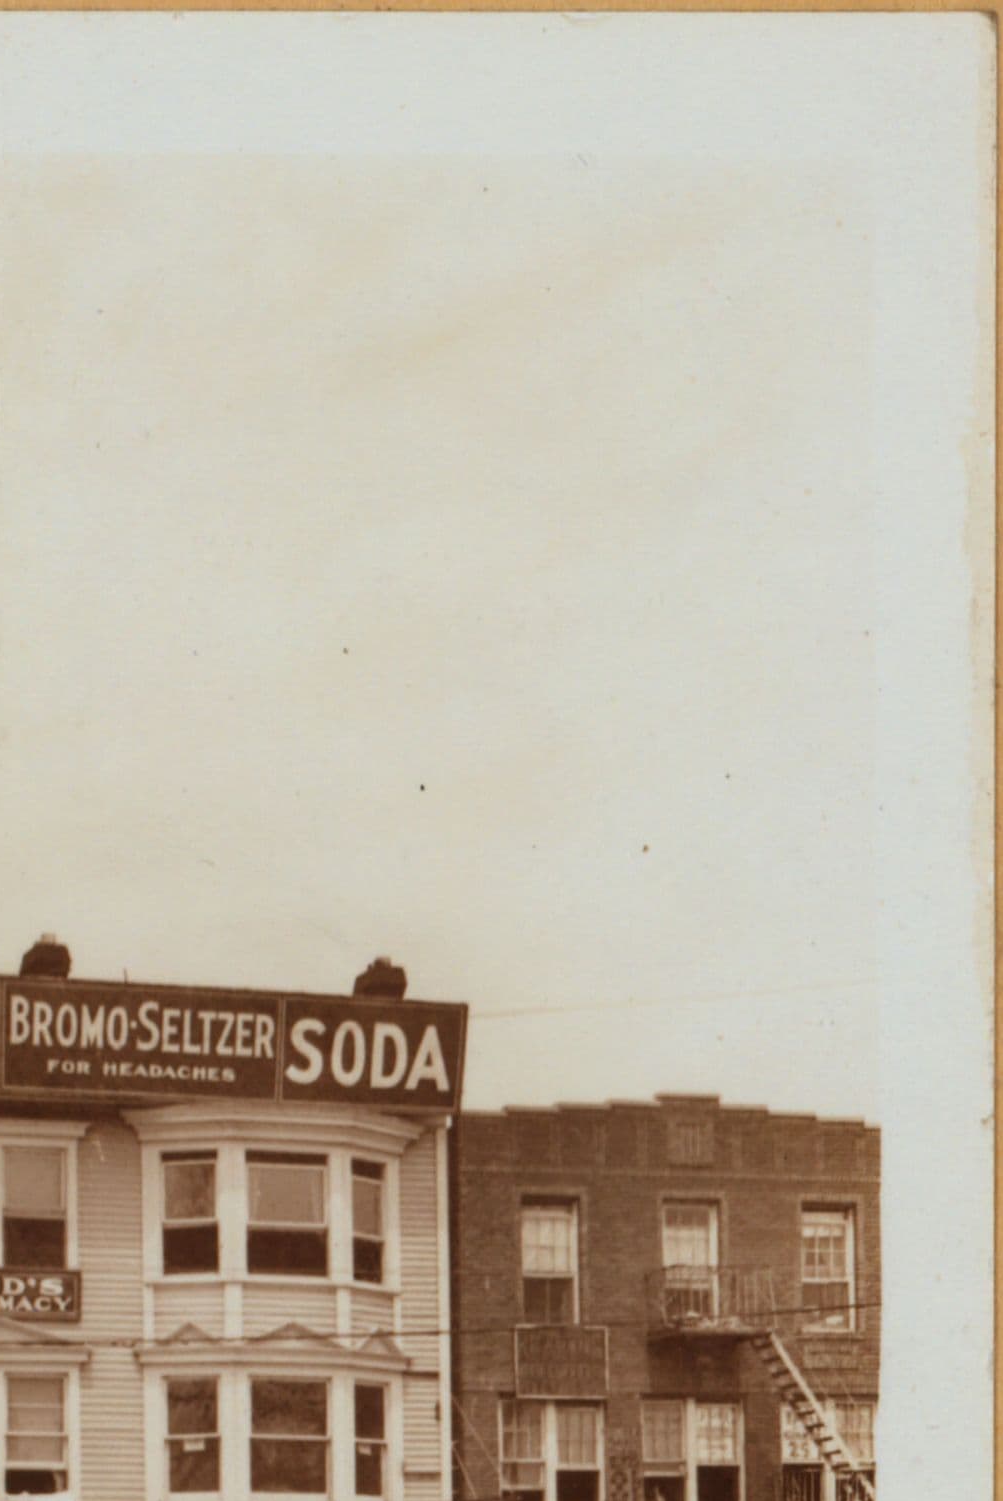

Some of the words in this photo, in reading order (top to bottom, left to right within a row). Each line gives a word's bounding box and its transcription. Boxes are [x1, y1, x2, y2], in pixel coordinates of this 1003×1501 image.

[47, 1059, 91, 1075] FOR
[103, 1061, 236, 1082] HEADACHES
[284, 1018, 450, 1092] SODA
